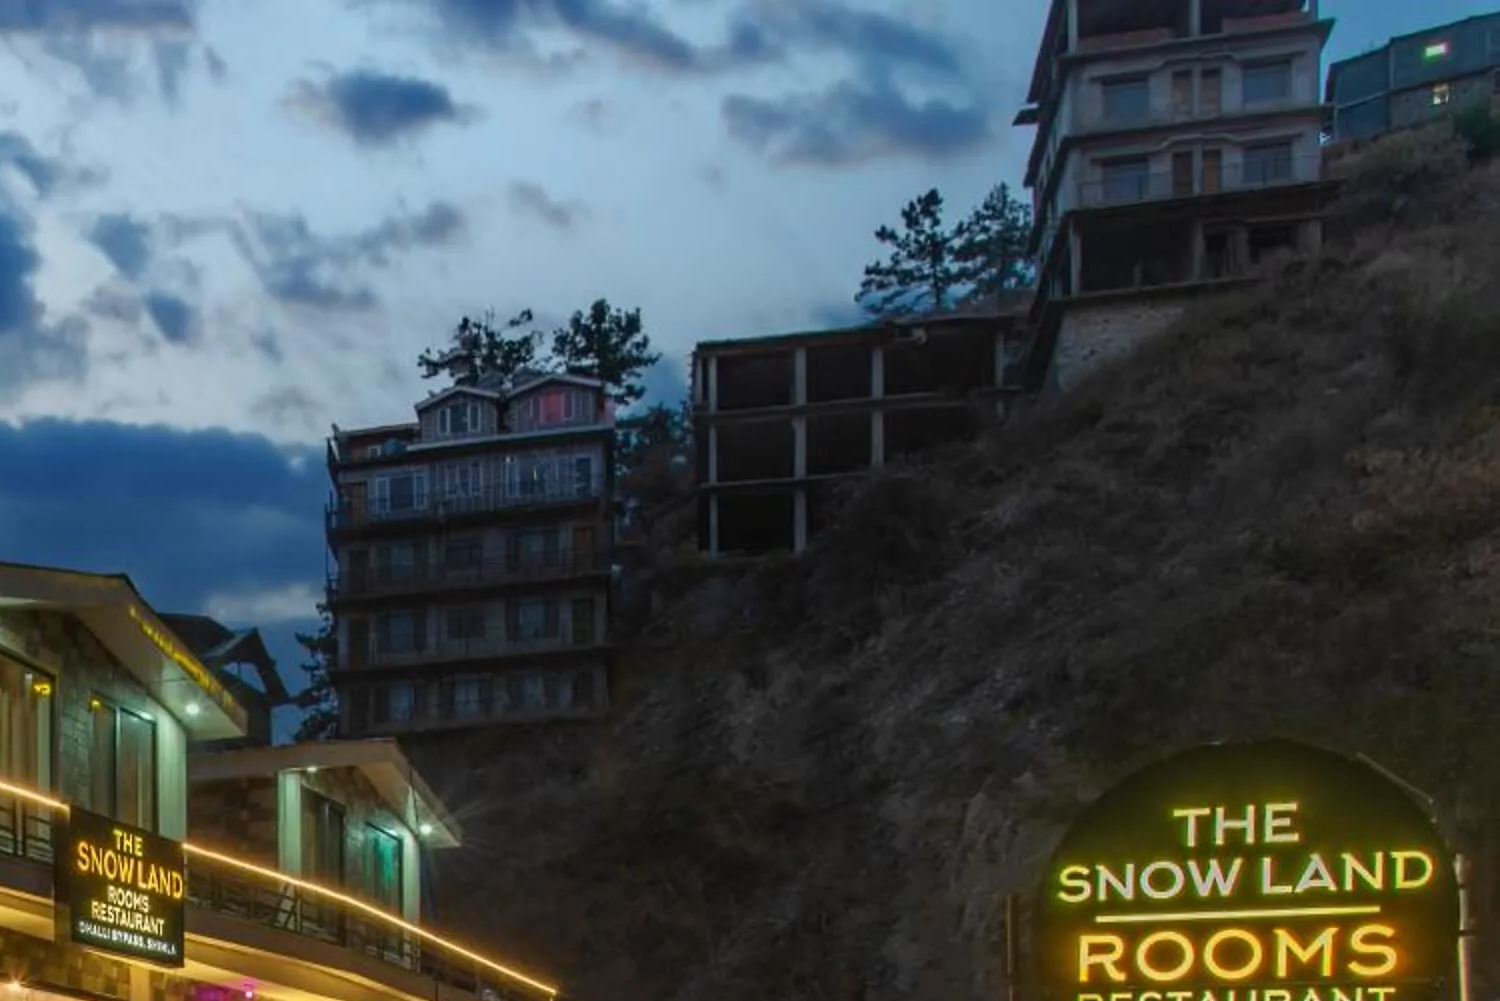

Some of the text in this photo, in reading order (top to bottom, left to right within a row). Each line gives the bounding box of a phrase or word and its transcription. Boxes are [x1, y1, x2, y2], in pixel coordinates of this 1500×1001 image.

[113, 829, 143, 857] THE
[1173, 803, 1300, 848] THE
[1058, 851, 1434, 903] SNOW LAND
[91, 899, 165, 937] RESTAURANT
[107, 885, 150, 914] ROOMS
[1078, 923, 1398, 983] ROOMS
